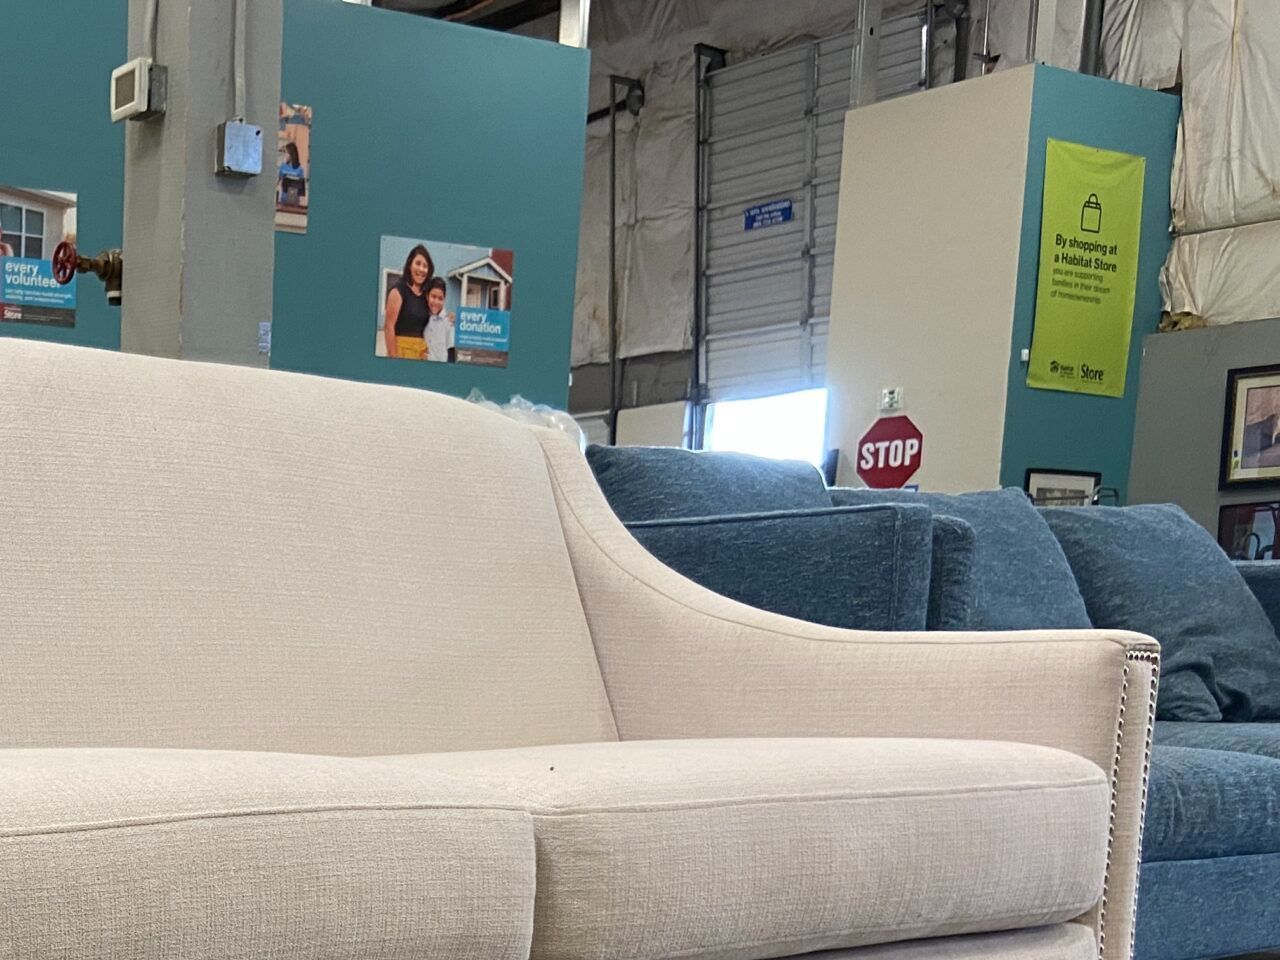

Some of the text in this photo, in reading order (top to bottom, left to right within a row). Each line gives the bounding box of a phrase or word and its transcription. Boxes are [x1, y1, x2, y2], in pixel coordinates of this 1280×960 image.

[1055, 233, 1117, 256] By shopping at
[5, 262, 39, 277] every
[1054, 252, 1117, 273] a Habitat Store
[460, 311, 487, 323] every
[459, 320, 501, 335] donation
[1080, 363, 1104, 381] Store
[860, 438, 919, 470] STOP
